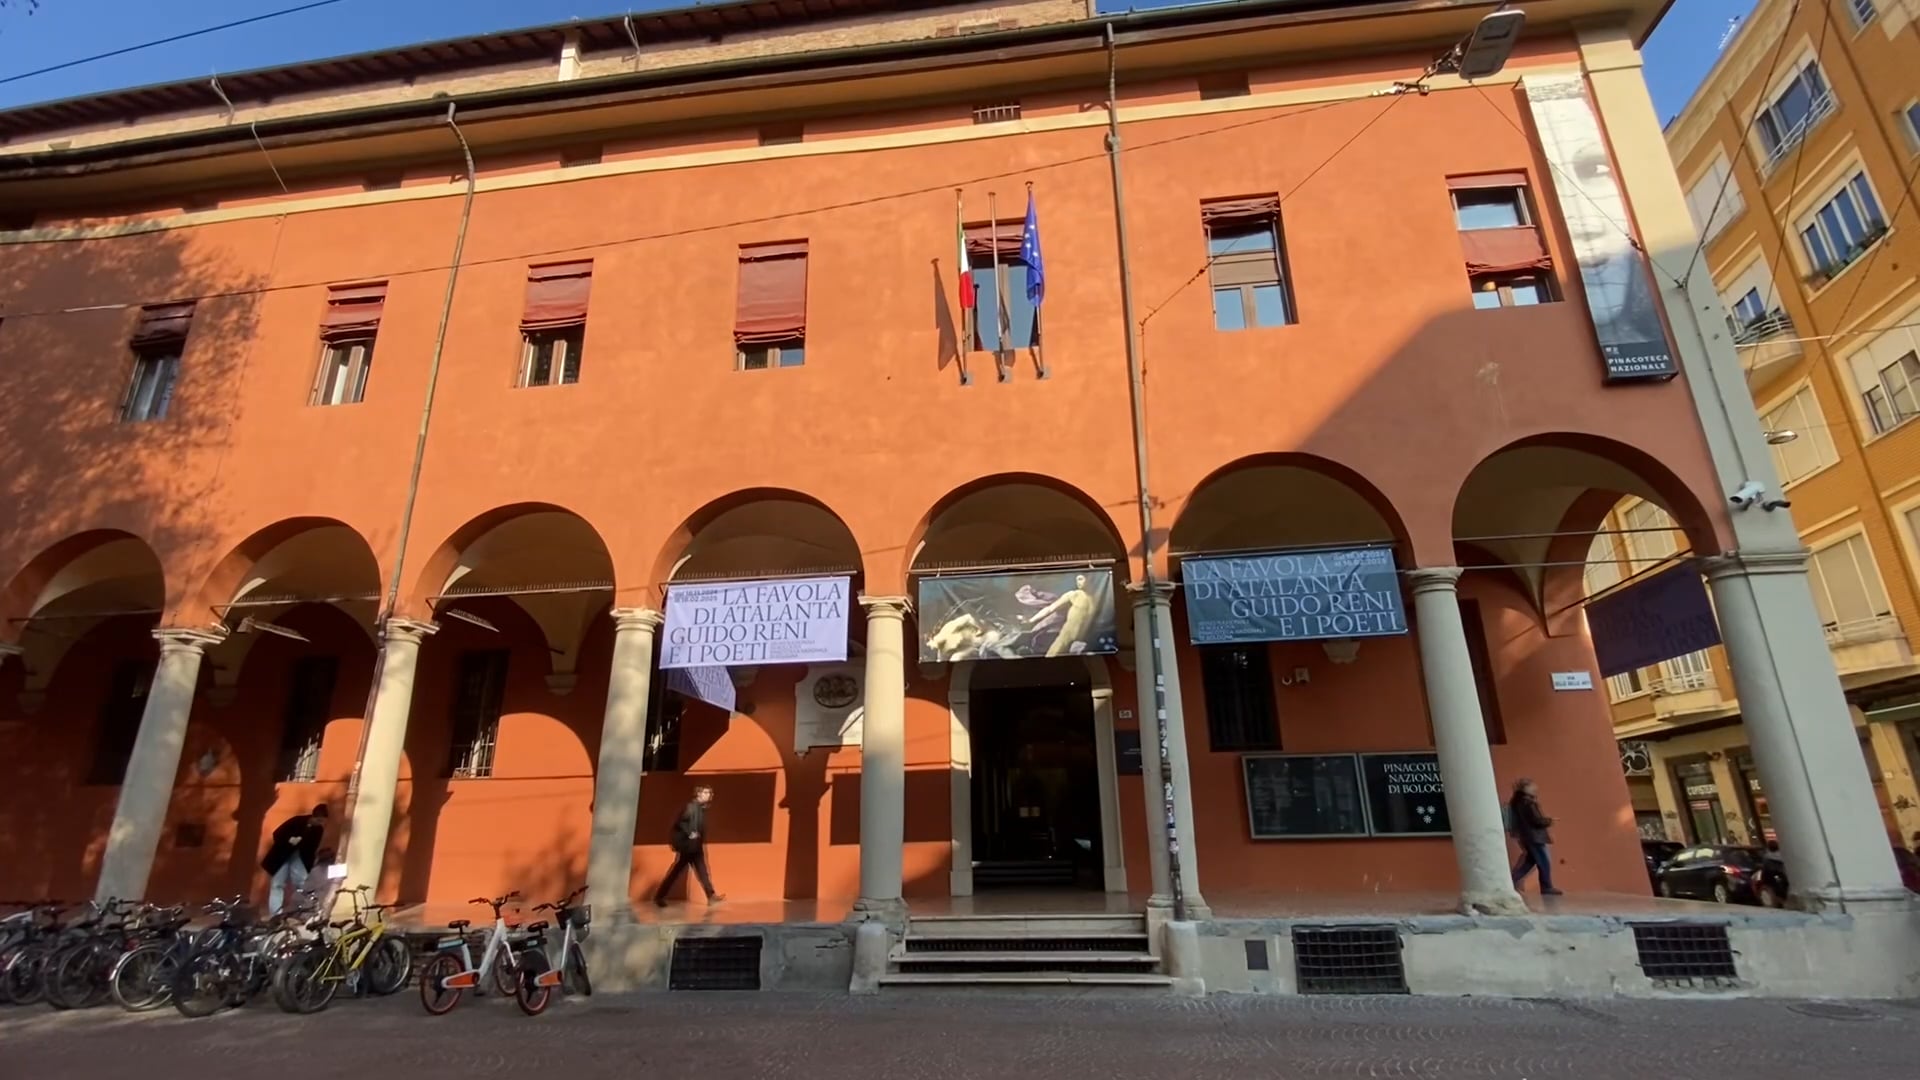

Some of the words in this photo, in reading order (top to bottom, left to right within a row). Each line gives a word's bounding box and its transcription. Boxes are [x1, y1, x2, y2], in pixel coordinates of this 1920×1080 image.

[1608, 355, 1669, 364] PINACOTECA
[1610, 363, 1666, 371] NAZIONALE
[1191, 561, 1221, 580] LA
[1229, 555, 1329, 578] FAVOLA
[723, 586, 749, 605] LA
[756, 583, 841, 603] FAVOLA
[1194, 580, 1220, 599] DI
[1228, 572, 1366, 598] ATALANTA
[694, 607, 717, 625] DI
[722, 601, 841, 623] ATALANTA
[1231, 594, 1320, 618] GUIDO
[1328, 590, 1395, 613] RENI
[670, 624, 747, 644] GUIDO
[754, 621, 807, 640] RENI
[1280, 616, 1295, 636] E
[1301, 616, 1309, 635] I
[1316, 611, 1400, 633] POETI
[670, 646, 681, 664] E
[687, 646, 693, 663] I
[700, 643, 767, 662] POETI
[1388, 784, 1400, 794] DI
